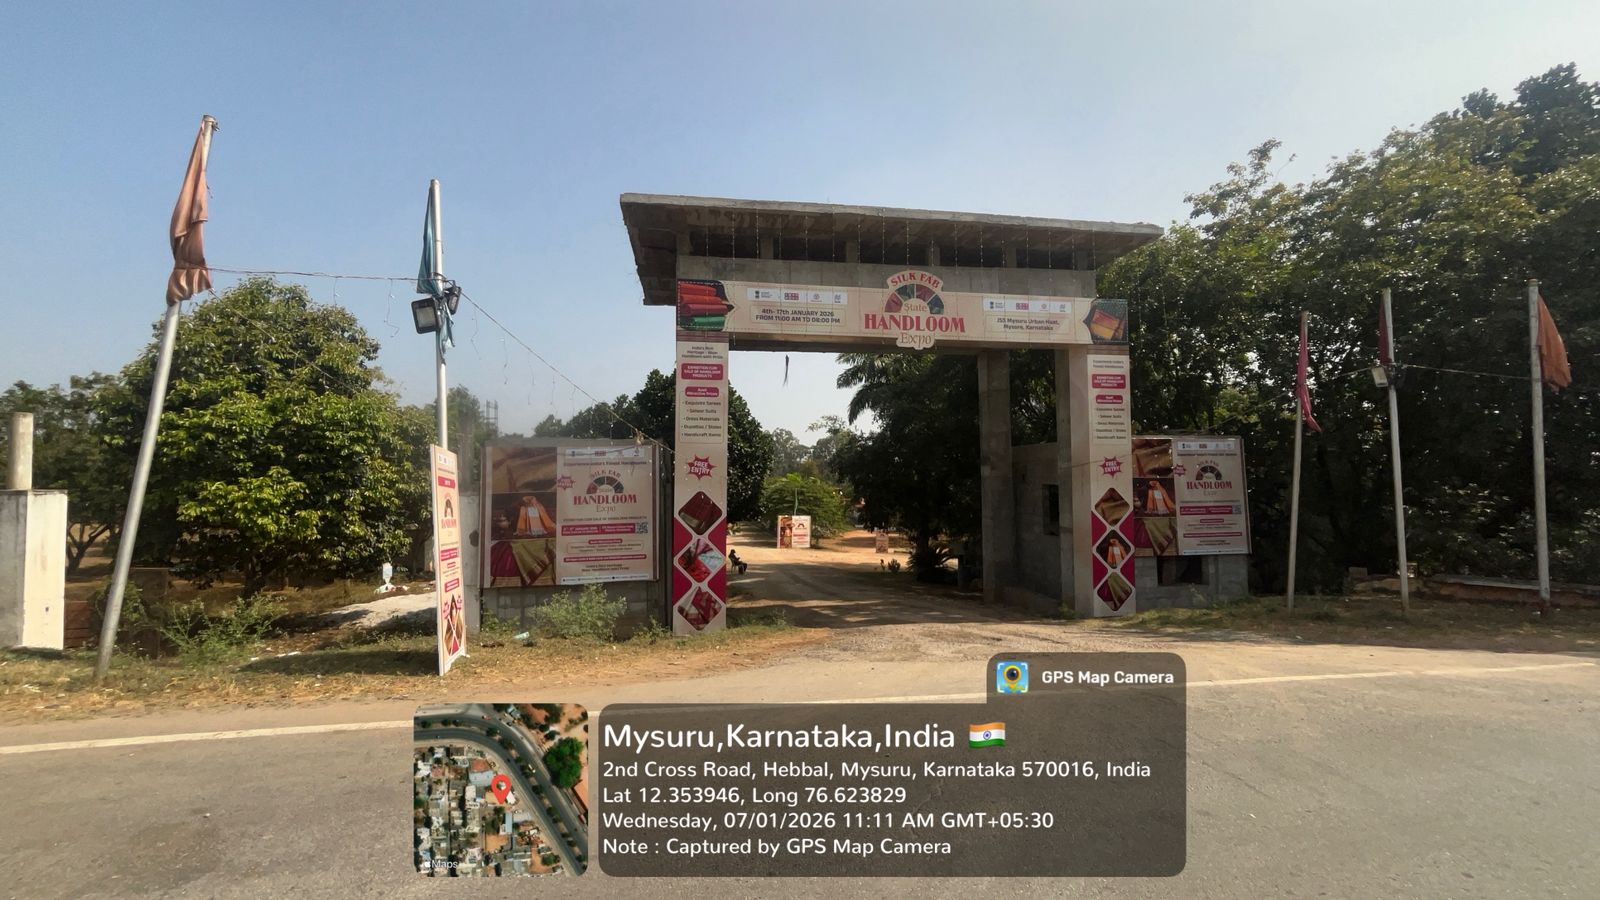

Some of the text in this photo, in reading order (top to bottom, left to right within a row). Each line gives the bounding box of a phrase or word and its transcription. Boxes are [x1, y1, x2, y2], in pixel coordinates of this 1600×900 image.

[890, 272, 941, 289] SILK FAB
[903, 302, 928, 312] State
[863, 313, 966, 333] HANDLOOM
[900, 332, 932, 347] Expo
[694, 460, 709, 468] FREE
[690, 466, 710, 475] ENTRY
[1186, 480, 1233, 490] HANDLOOM
[573, 494, 638, 506] HANDLOOM
[596, 505, 616, 514] Expo
